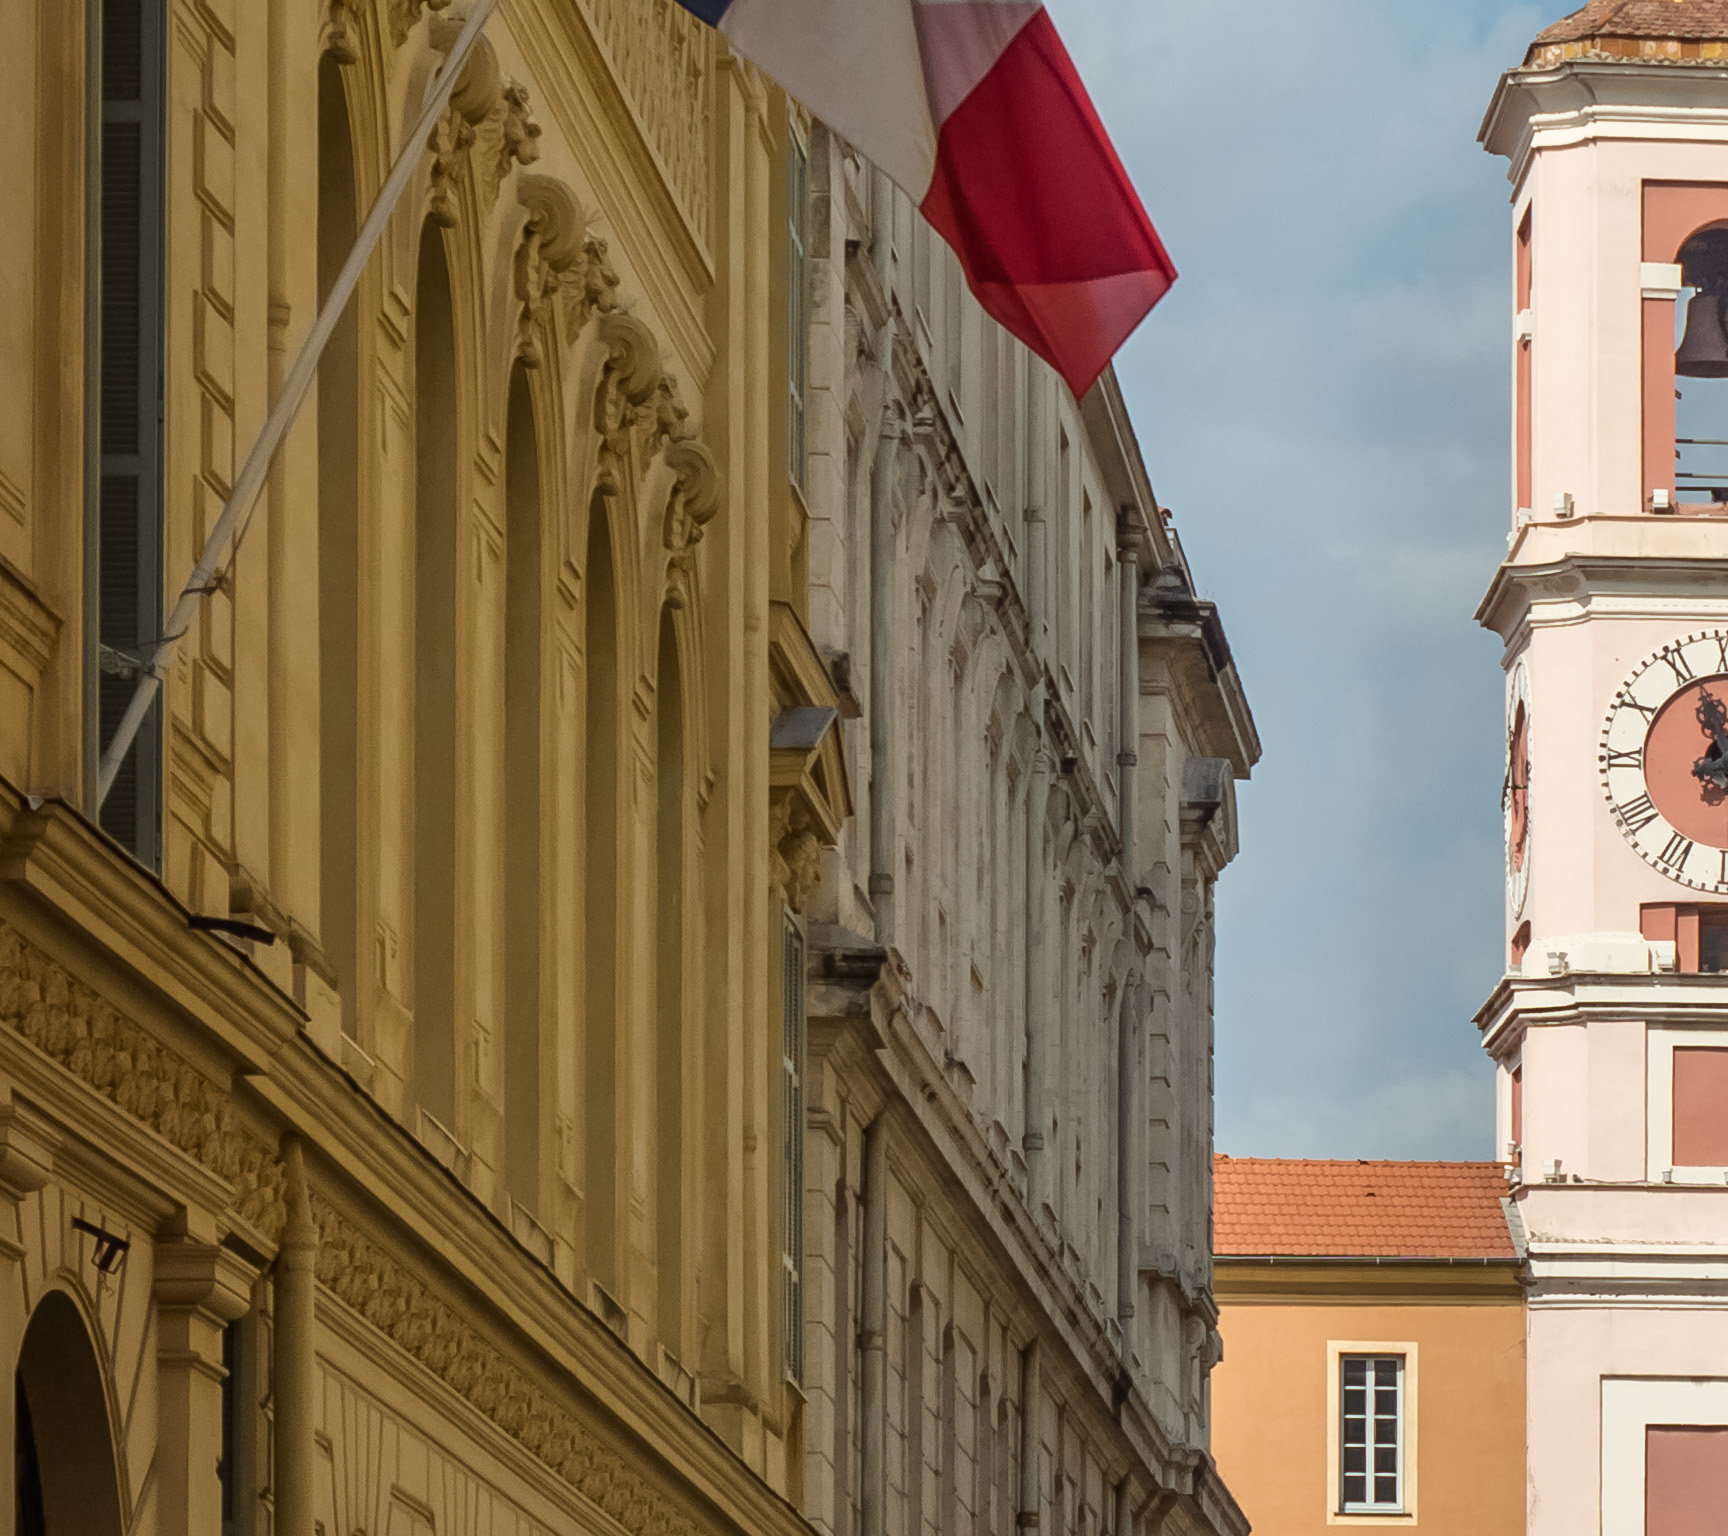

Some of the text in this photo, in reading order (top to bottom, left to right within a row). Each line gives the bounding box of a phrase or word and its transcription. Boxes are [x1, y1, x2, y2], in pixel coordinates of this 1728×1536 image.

[1660, 648, 1697, 687] XI
[1620, 689, 1658, 725] X
[1607, 747, 1643, 770] IX
[1615, 790, 1659, 836] VIII
[1657, 830, 1695, 874] VII
